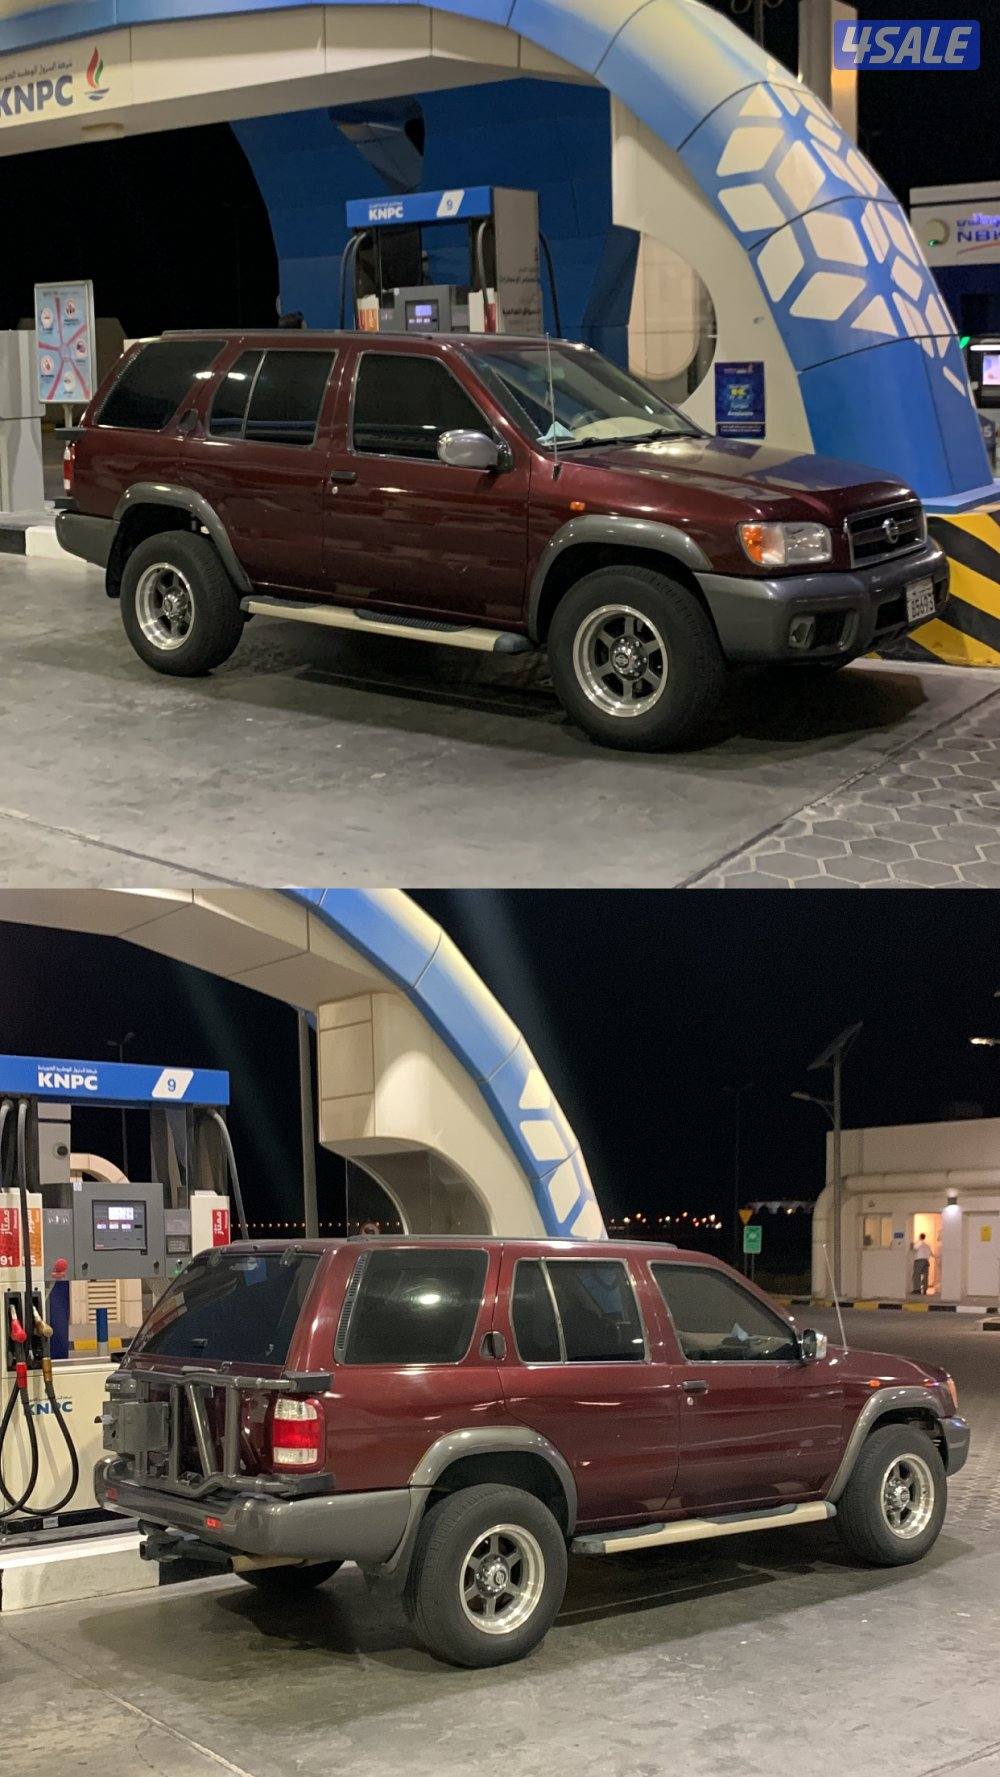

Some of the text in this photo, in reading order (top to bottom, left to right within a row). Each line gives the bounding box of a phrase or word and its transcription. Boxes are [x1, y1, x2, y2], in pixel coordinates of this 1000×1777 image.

[369, 206, 403, 221] KNPC
[38, 1072, 98, 1091] KNPC
[168, 1078, 177, 1093] 9
[0, 1255, 13, 1266] 91
